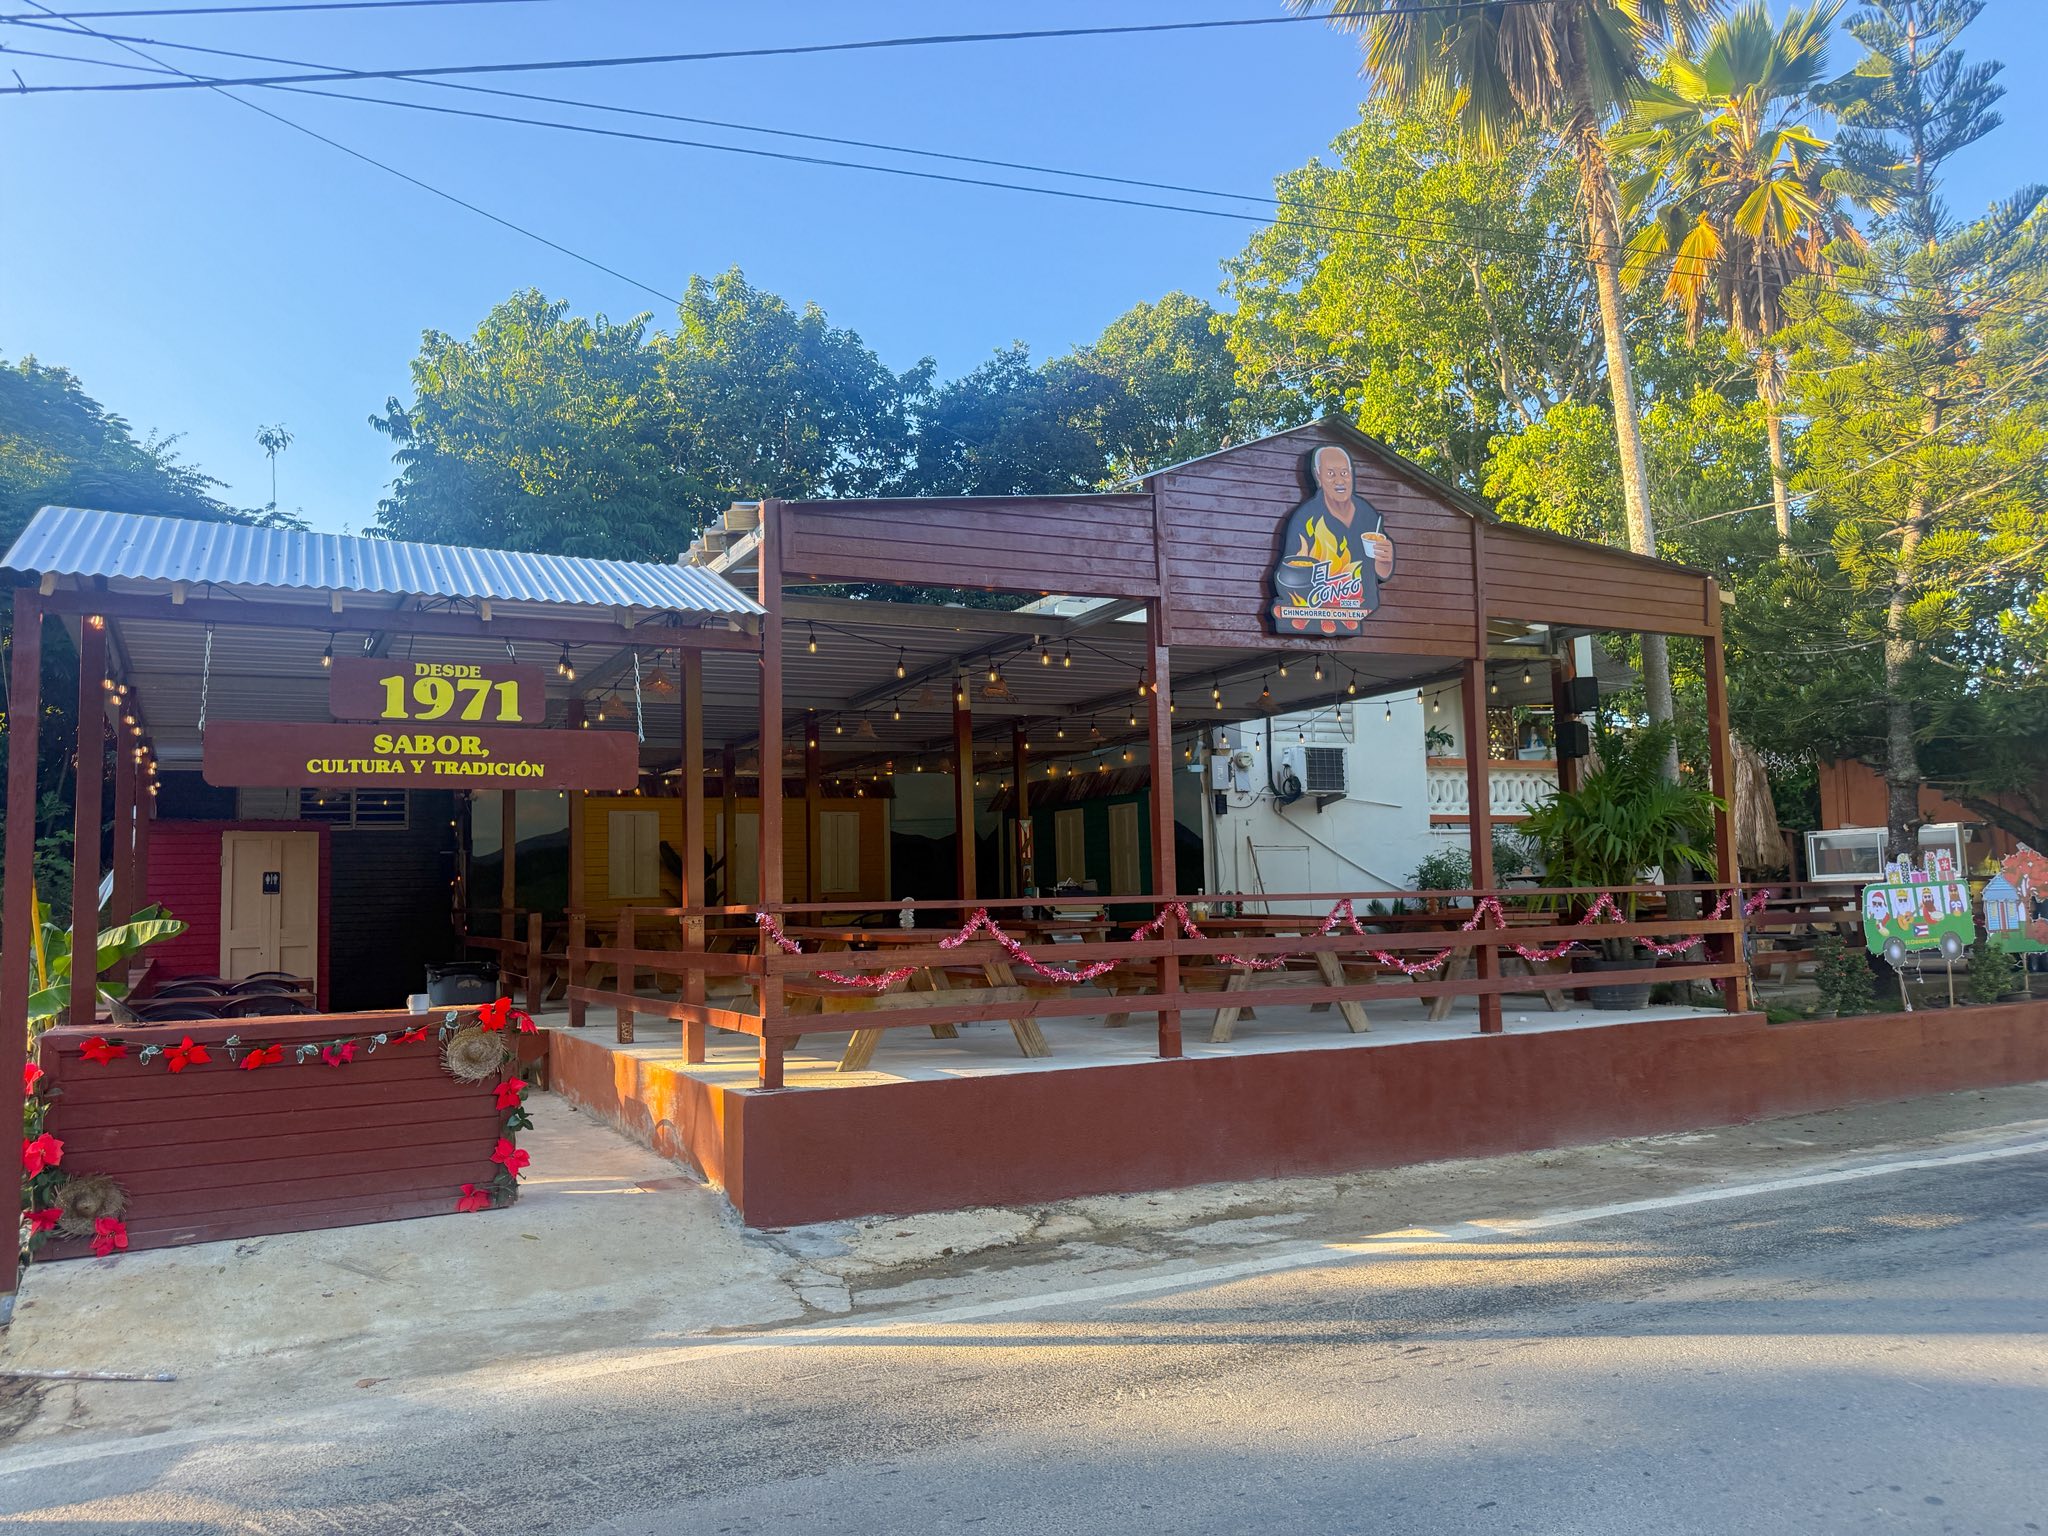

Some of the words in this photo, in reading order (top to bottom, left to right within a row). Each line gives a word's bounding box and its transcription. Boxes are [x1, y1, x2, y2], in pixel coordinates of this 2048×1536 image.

[1311, 560, 1352, 586] EL
[1308, 578, 1361, 609] CONGO
[1283, 609, 1331, 617] CHINCHORREO
[414, 663, 482, 678] DESDE
[379, 675, 523, 722] 1971
[373, 733, 490, 758] SABOR,
[306, 758, 406, 775] CULTURA
[411, 760, 426, 774] Y
[432, 759, 545, 778] TRADICIÓN
